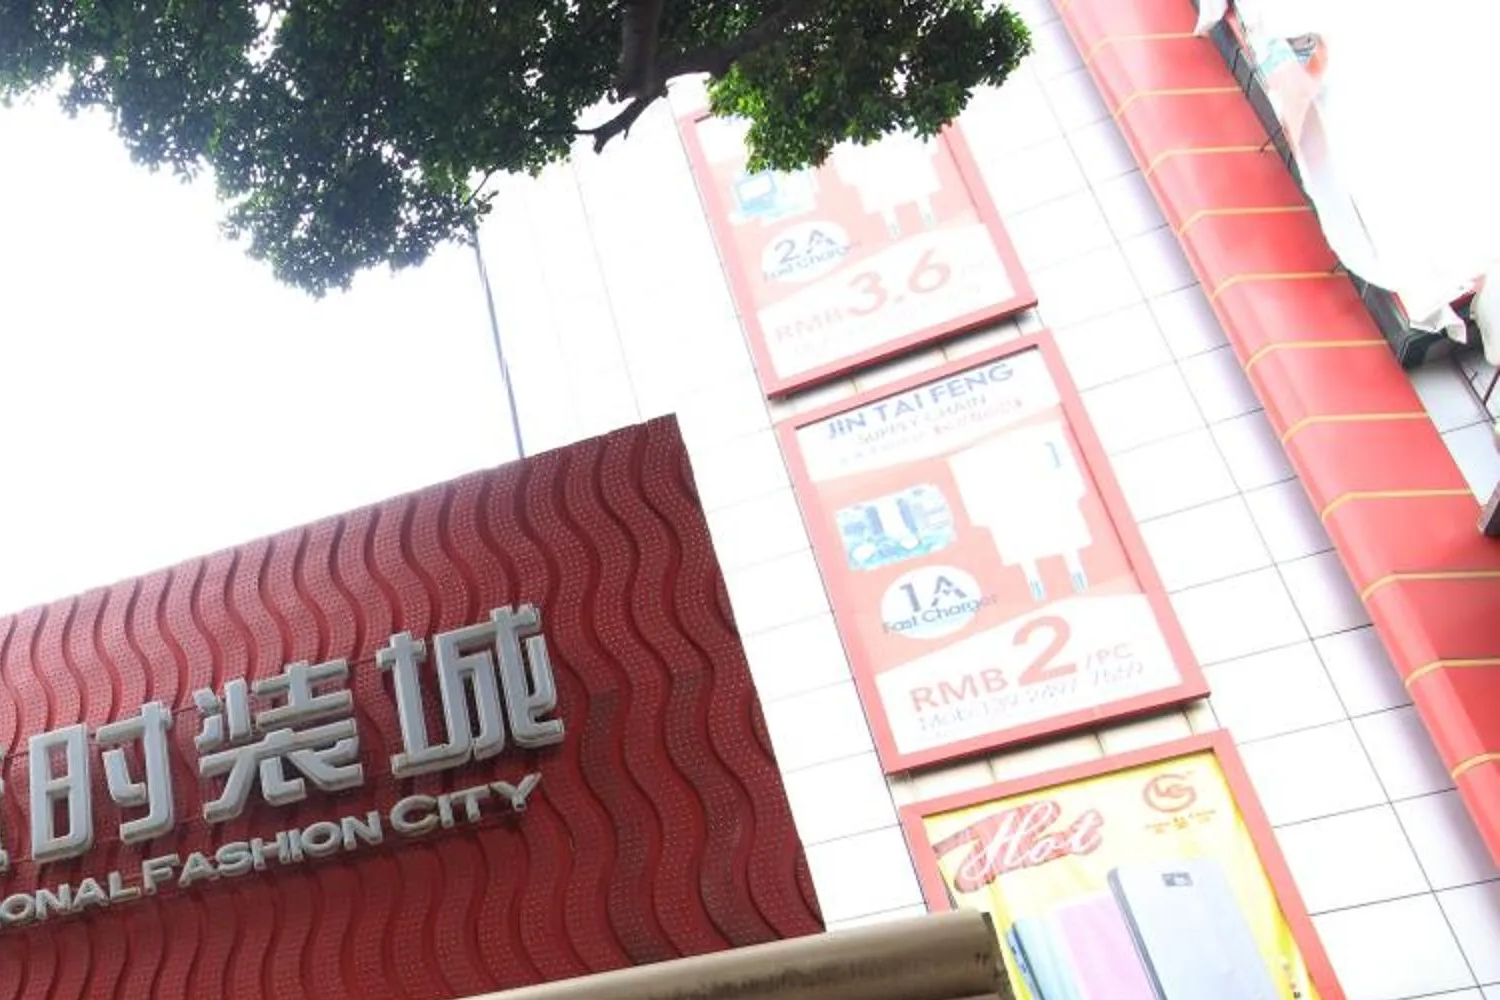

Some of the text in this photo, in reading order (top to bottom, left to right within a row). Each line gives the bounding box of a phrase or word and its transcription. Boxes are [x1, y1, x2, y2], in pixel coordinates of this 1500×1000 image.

[844, 246, 952, 317] 3.6
[826, 410, 867, 440] JIN
[874, 392, 926, 423] TAI
[928, 362, 1015, 405] FENG
[881, 592, 998, 635] Fast Charger
[899, 574, 968, 614] 1A
[908, 667, 1010, 713] RMB
[1011, 614, 1079, 688] 2
[142, 810, 384, 897] FASHION
[390, 771, 542, 837] CITY
[954, 800, 1104, 886] Hot
